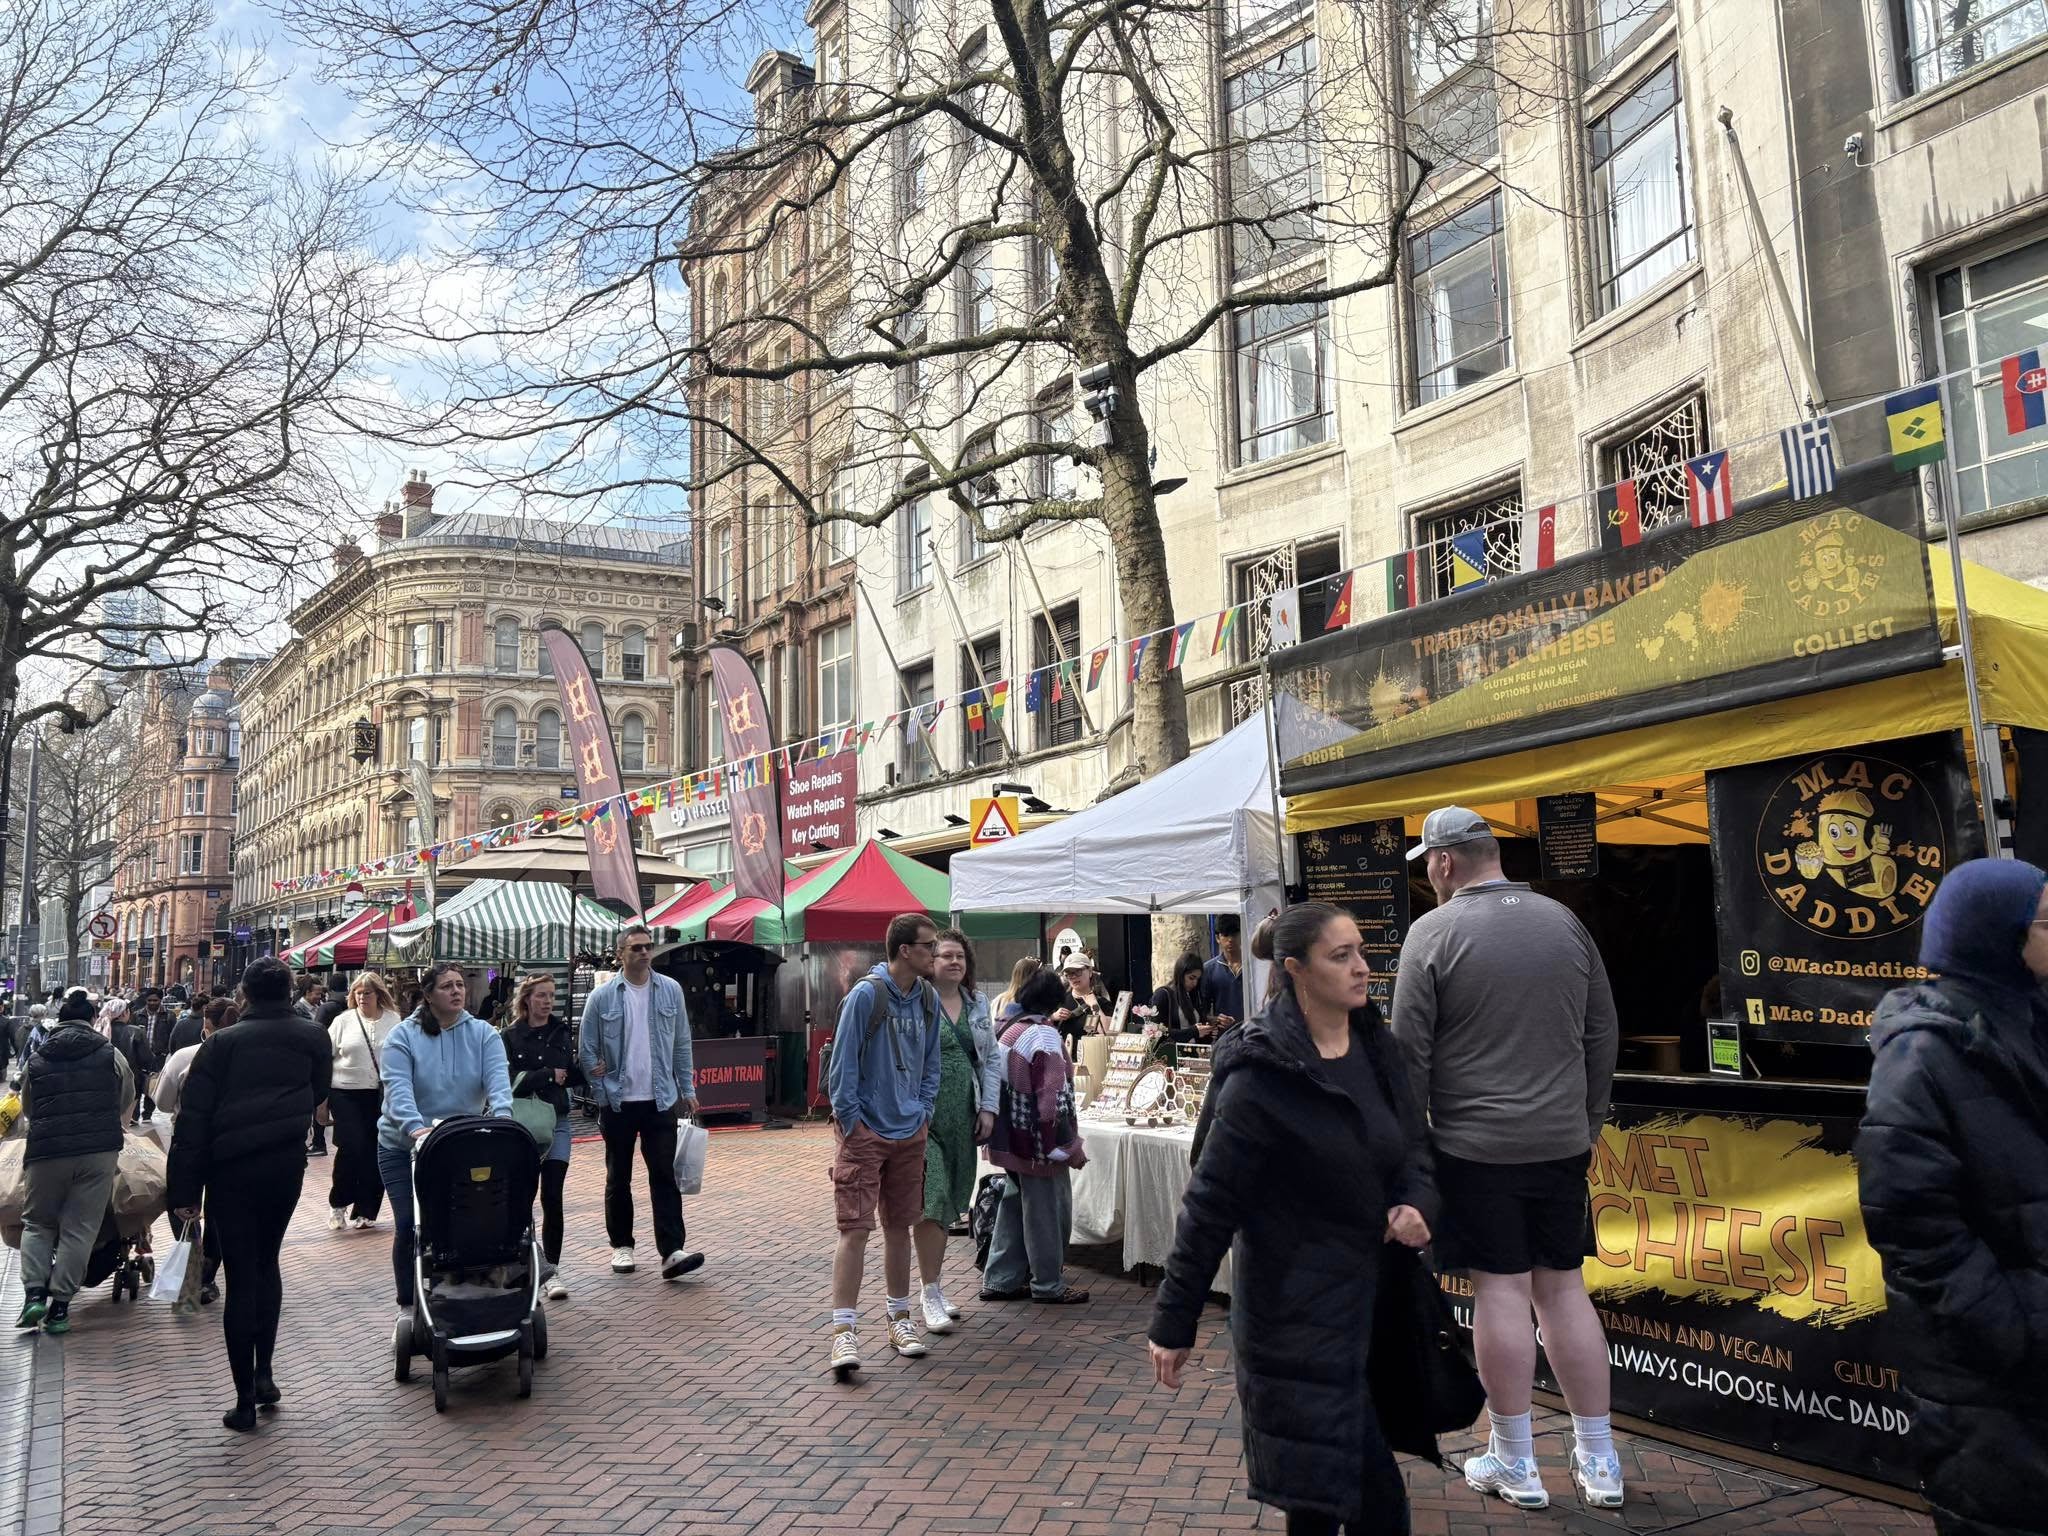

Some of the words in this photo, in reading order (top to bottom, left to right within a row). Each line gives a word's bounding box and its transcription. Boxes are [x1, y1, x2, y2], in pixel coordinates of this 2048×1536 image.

[1799, 514, 1861, 546] MAC
[1787, 554, 1885, 617] DADDIES
[1411, 592, 1576, 659] TRADITIONALLY
[1584, 566, 1666, 610] BAKED
[1527, 619, 1615, 663] CHEESE
[1793, 616, 1894, 657] COLLECT
[1484, 674, 1514, 690] GLUTEN
[1514, 669, 1536, 684] FREE
[1538, 666, 1556, 678] AND
[1557, 657, 1588, 673] VEGAN
[1493, 683, 1530, 701] OPTIONS
[1533, 673, 1579, 694] AVAILABLE
[1491, 709, 1523, 723] DADDIES
[1303, 745, 1344, 766] ORDER
[789, 779, 810, 796] Shoe
[811, 770, 842, 791] Repairs
[1791, 761, 1912, 801] MAC
[787, 801, 812, 820] Watch
[814, 795, 845, 815] Repairs
[792, 828, 806, 845] Key
[808, 822, 840, 841] Cutting
[1357, 857, 1368, 870] 8
[1379, 877, 1393, 890] 10
[1764, 846, 1942, 934] DADDIES
[1382, 904, 1397, 917] 12
[1384, 929, 1399, 942] 10
[1385, 959, 1400, 972] 10
[1769, 1006, 1814, 1022] Mac
[700, 1066, 732, 1085] STEAM
[734, 1064, 763, 1082] TRAIN
[1591, 1193, 1847, 1306] CHEESE
[1675, 1327, 1715, 1351] AND
[1719, 1334, 1793, 1372] VEGAN
[1683, 1362, 1780, 1408] CHOOSE
[1783, 1385, 1845, 1422] MAC
[1850, 1399, 1911, 1436] DADD
